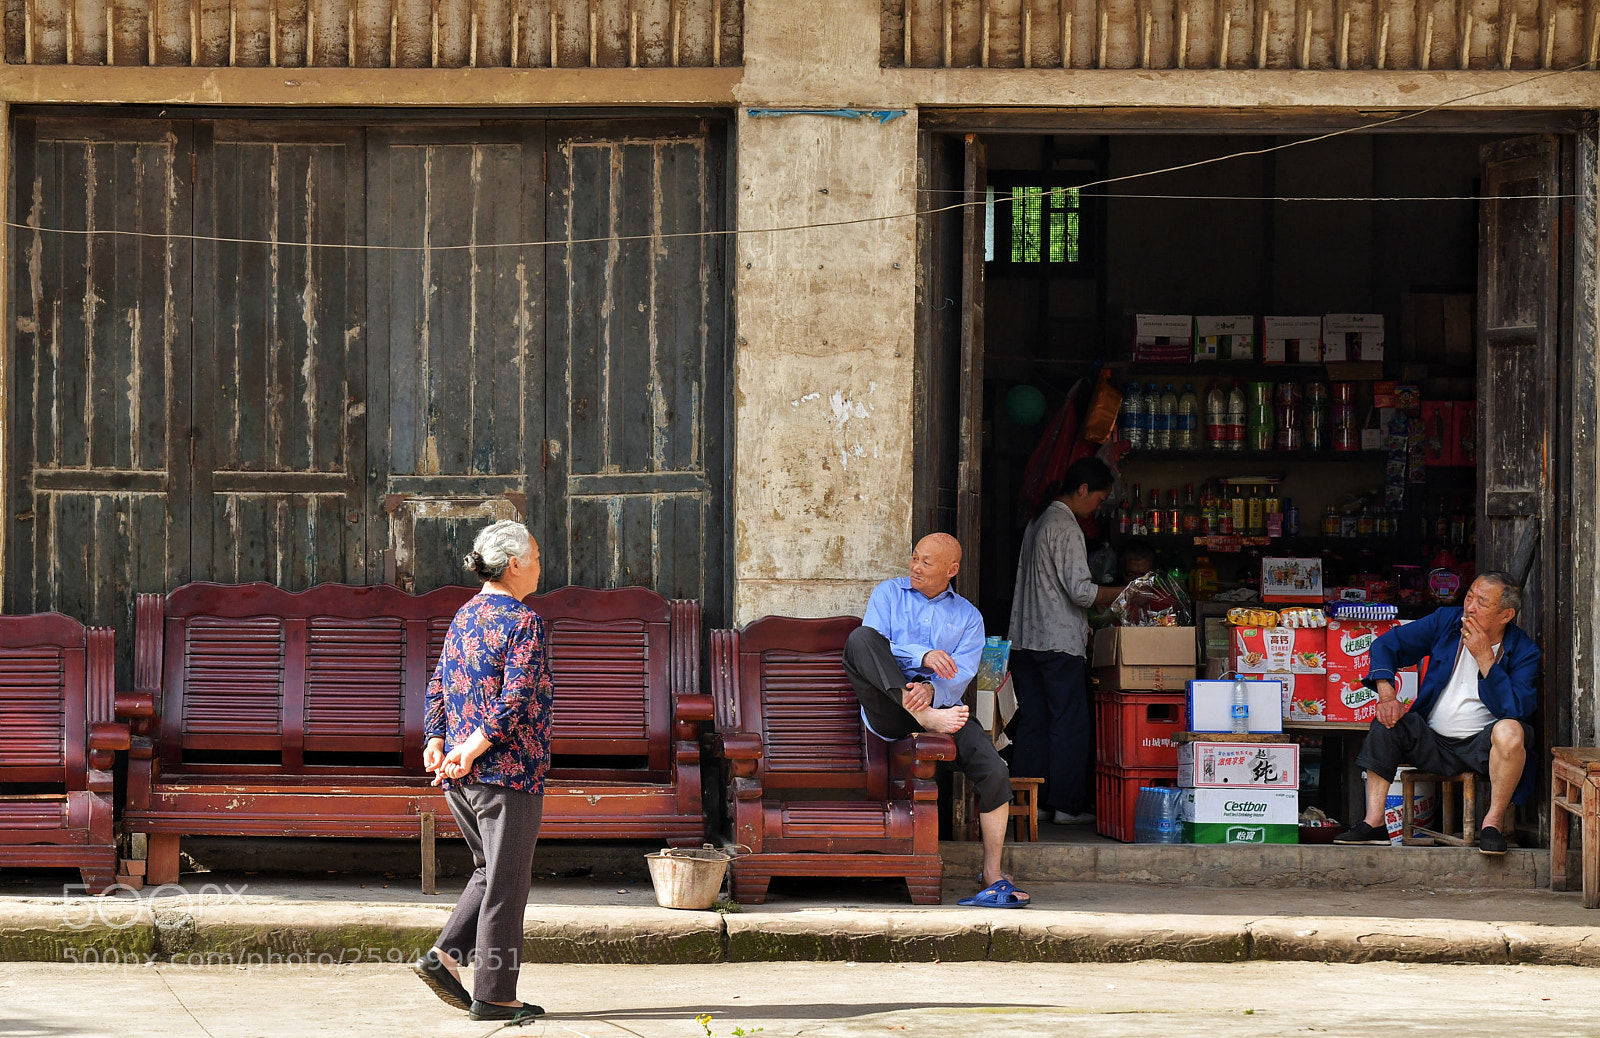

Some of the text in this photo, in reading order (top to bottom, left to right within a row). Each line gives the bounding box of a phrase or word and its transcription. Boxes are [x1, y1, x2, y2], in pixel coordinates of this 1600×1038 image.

[1270, 635, 1289, 645] 高钙
[1345, 635, 1372, 653] 优酸乳
[1353, 655, 1371, 670] 乳饮
[1345, 688, 1375, 705] 优酸乳
[1353, 703, 1377, 722] 乳饮料
